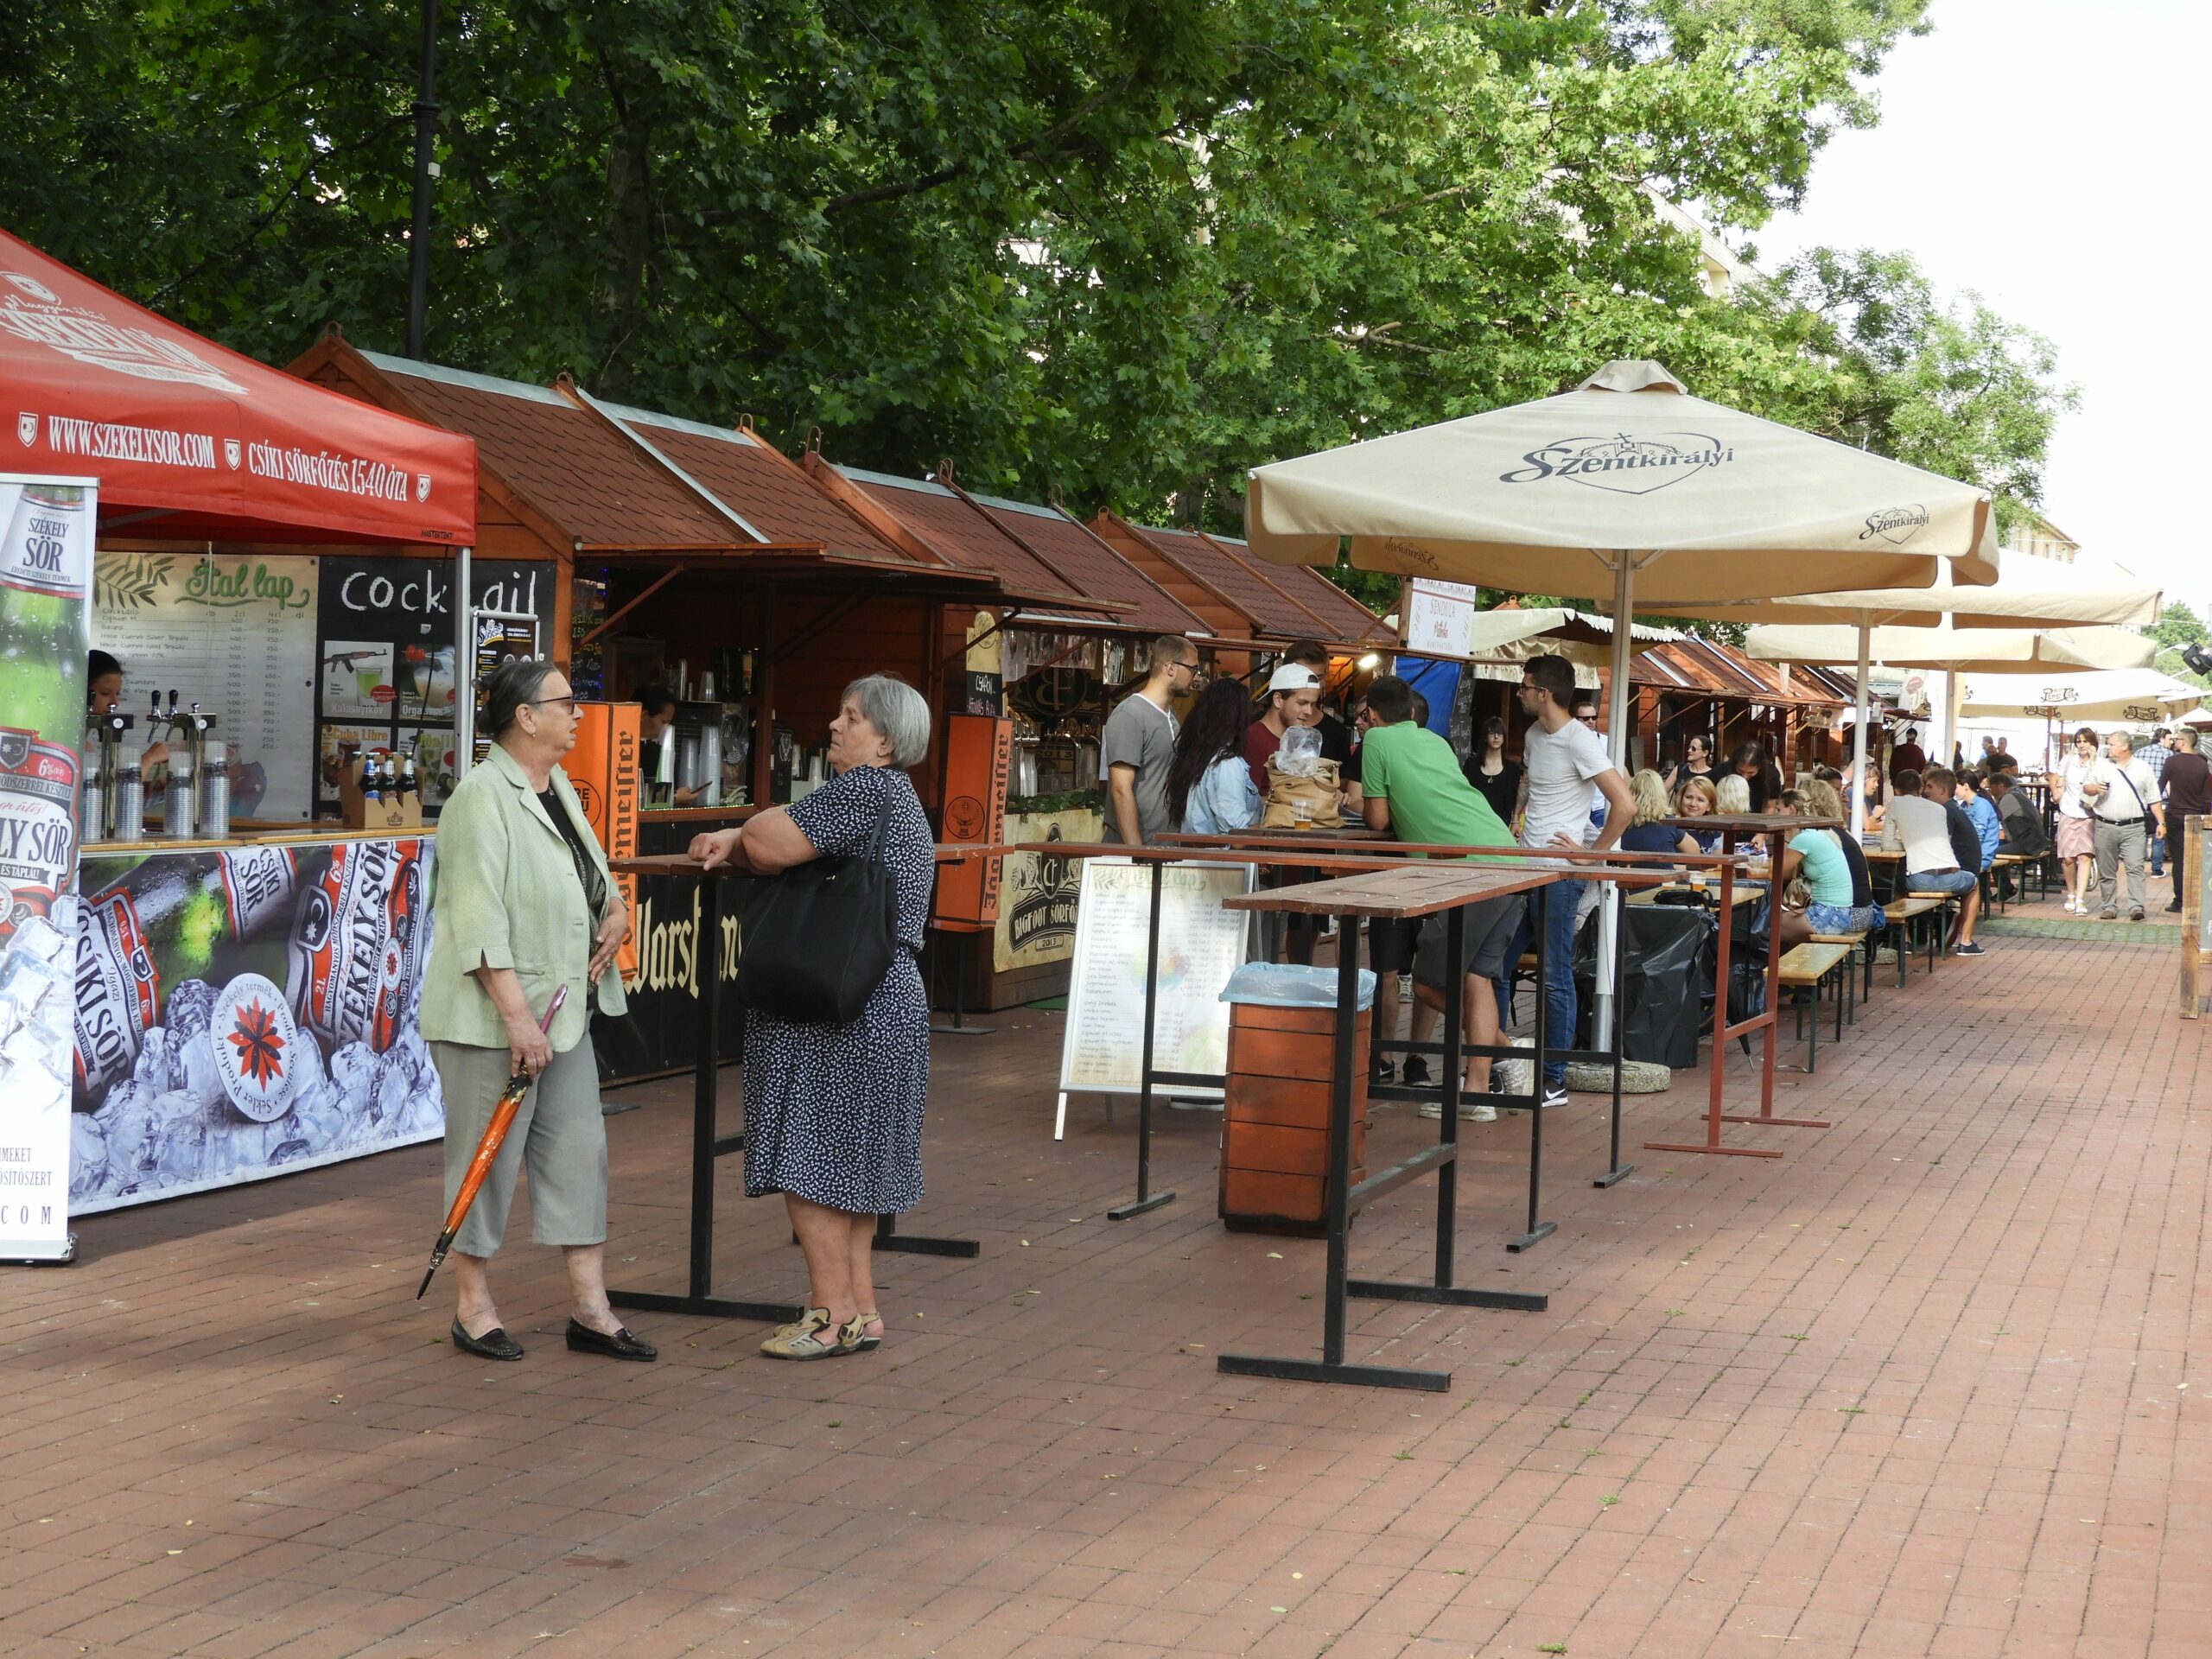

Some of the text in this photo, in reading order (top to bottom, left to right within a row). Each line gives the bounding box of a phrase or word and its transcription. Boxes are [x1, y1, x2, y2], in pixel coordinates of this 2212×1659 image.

[49, 416, 216, 468] WWW.SZEKELYSOR.COM
[249, 439, 408, 502] CSÍKI SÖRFŐZÉS 1540 ÓTA
[1499, 448, 1734, 483] Szentkirályi
[28, 516, 69, 538] SZÉKELY
[1859, 513, 1929, 540] Szentkirályi
[22, 536, 64, 572] SÖR
[186, 562, 294, 610] Ital lap
[362, 728, 388, 741] Libre
[28, 817, 68, 865] SÖR
[240, 859, 265, 914] SÖR
[260, 849, 281, 899] CSÍKI
[1014, 906, 1047, 940] BIGFOOT
[1042, 938, 1057, 947] 2013
[105, 967, 124, 1003] Igazi
[246, 982, 273, 1000] termék
[315, 977, 326, 995] 2L
[86, 1007, 130, 1077] SÖR
[277, 1001, 298, 1102] Produs Secuiesc
[216, 1036, 243, 1097] Produkt
